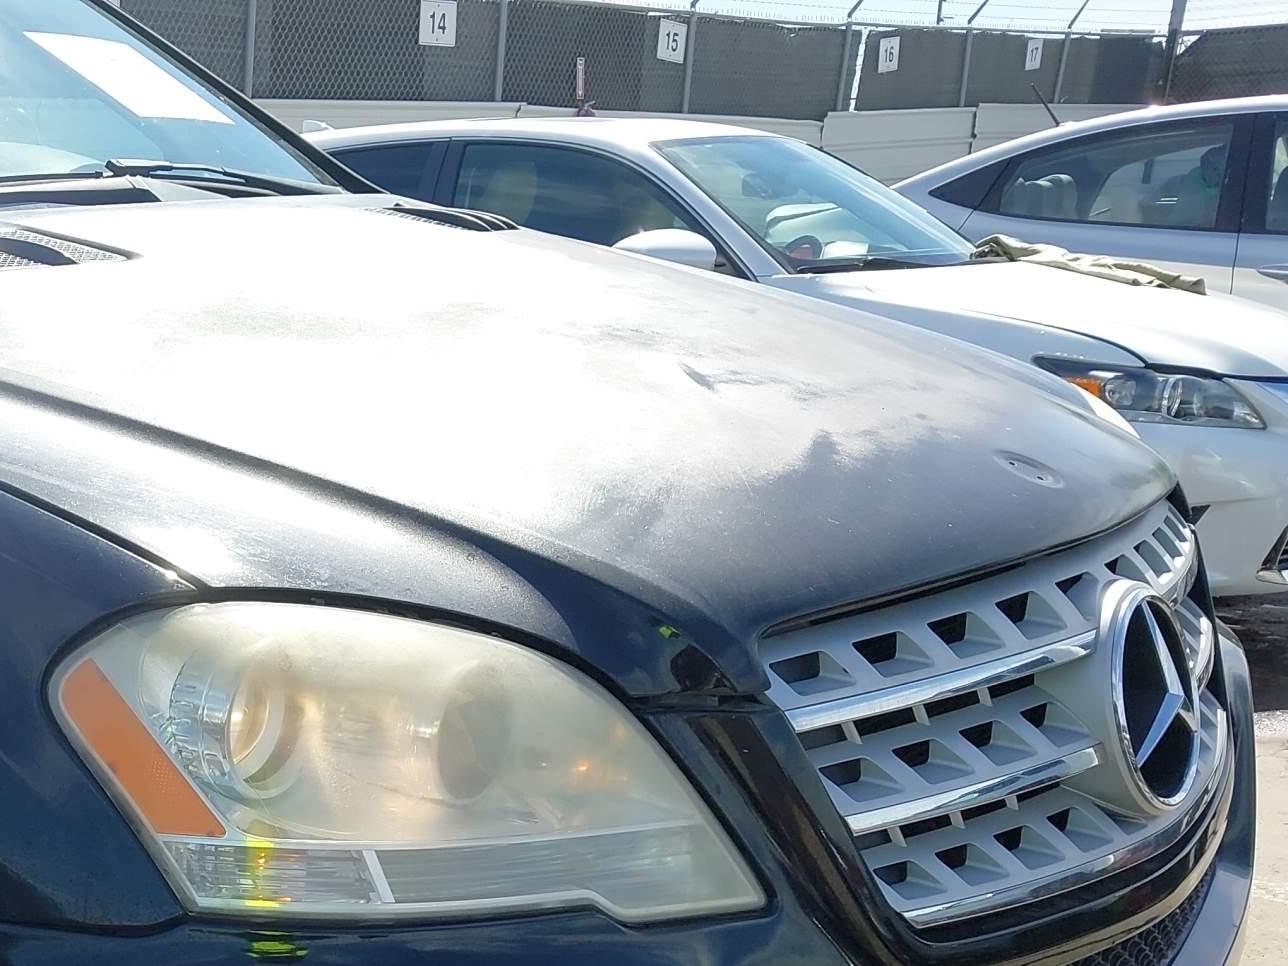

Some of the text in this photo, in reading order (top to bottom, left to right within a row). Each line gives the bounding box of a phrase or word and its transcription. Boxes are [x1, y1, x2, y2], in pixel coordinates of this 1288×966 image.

[429, 11, 447, 35] 14
[666, 31, 679, 52] 15
[884, 46, 894, 63] 16
